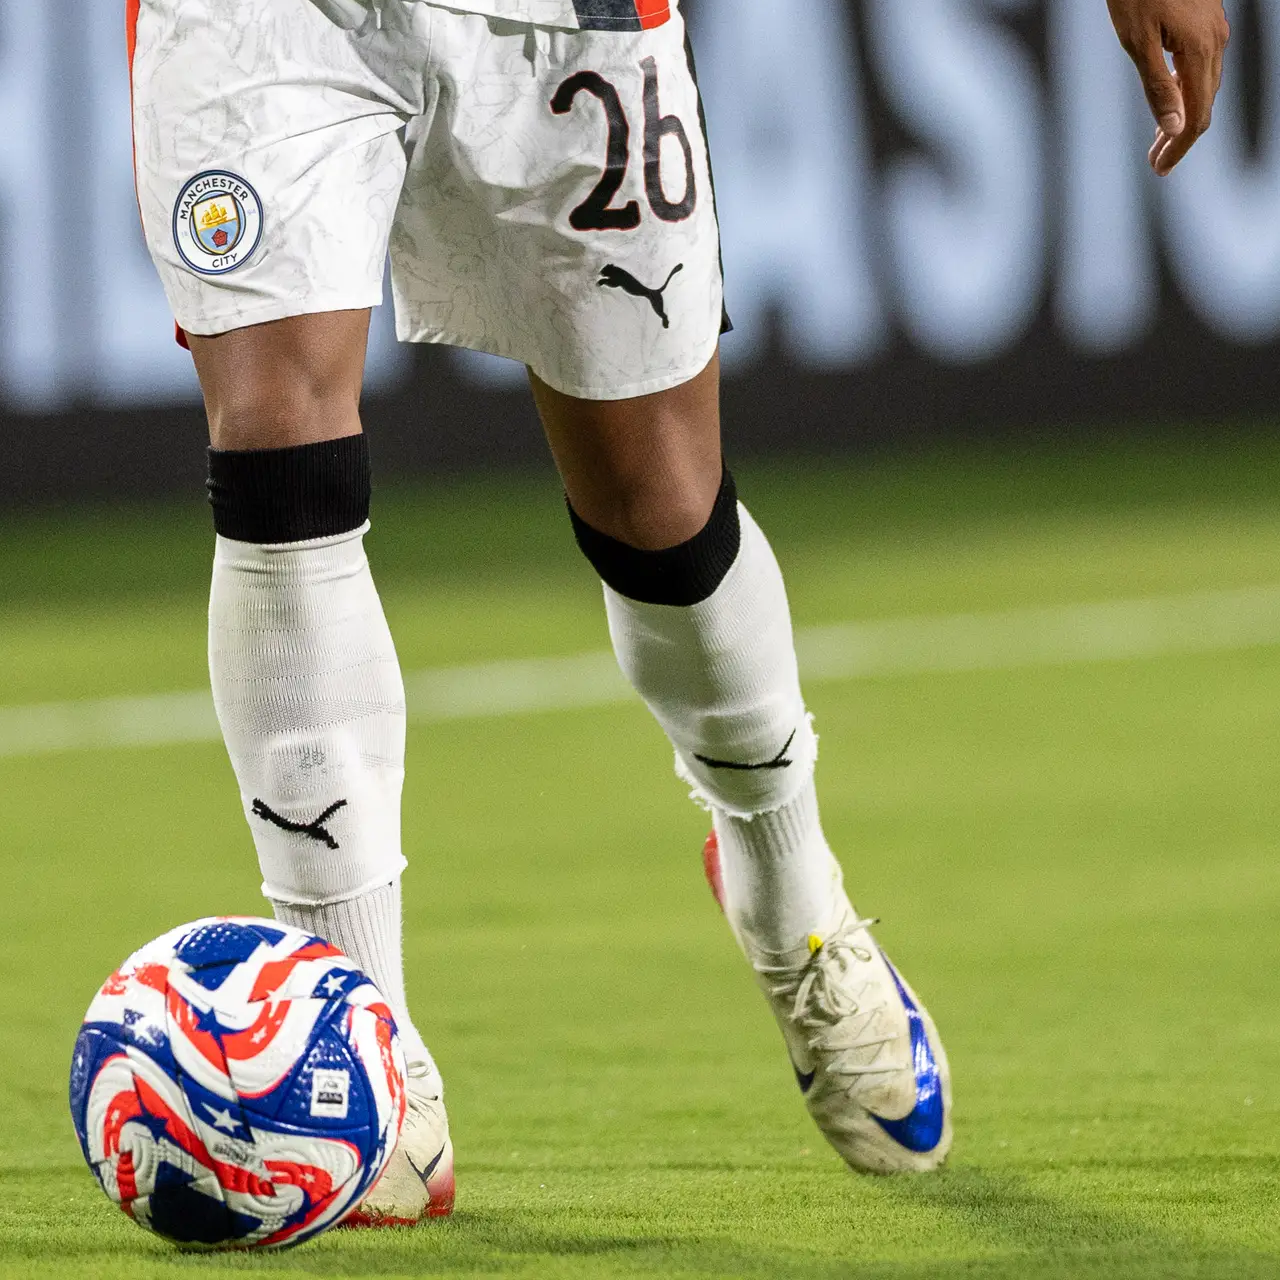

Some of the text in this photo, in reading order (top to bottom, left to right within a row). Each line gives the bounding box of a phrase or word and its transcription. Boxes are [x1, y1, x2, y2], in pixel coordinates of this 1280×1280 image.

[549, 54, 697, 232] 26
[179, 177, 249, 220] MANCHESTER
[211, 252, 238, 269] CITY
